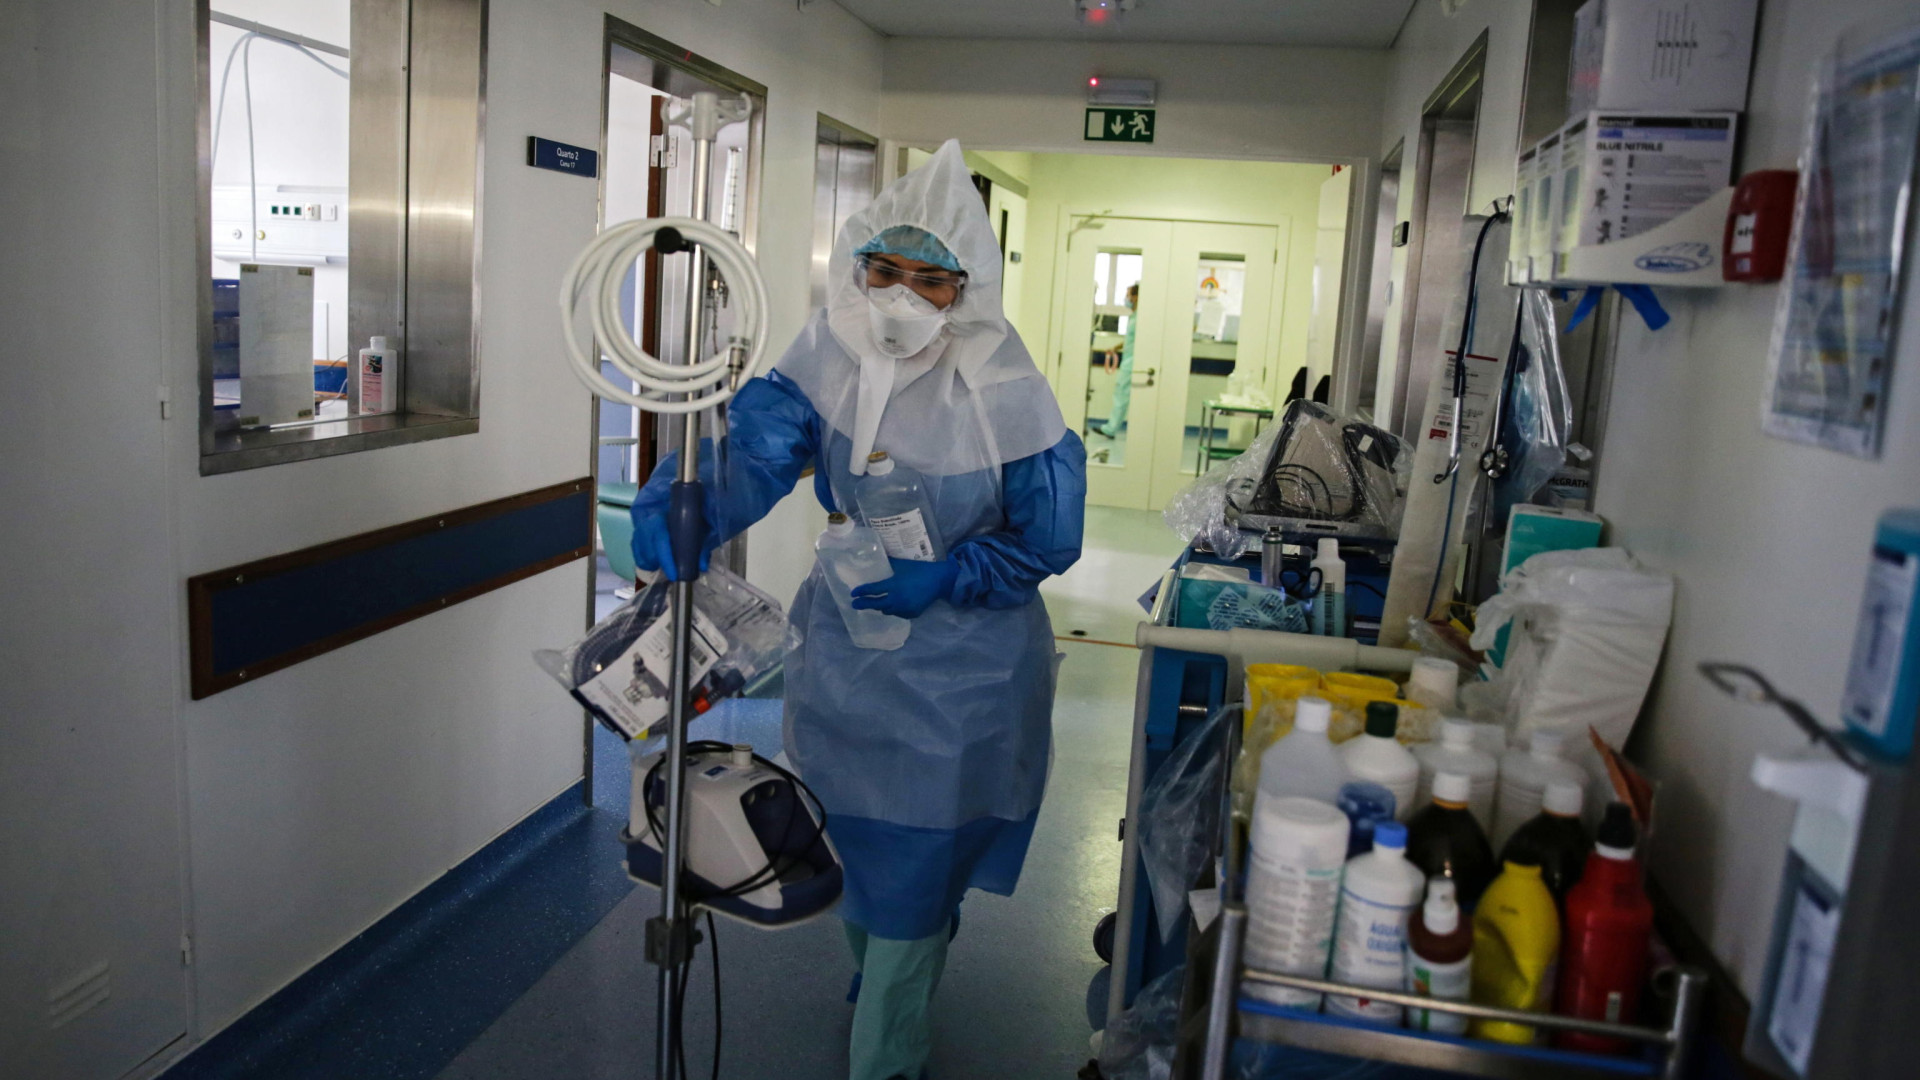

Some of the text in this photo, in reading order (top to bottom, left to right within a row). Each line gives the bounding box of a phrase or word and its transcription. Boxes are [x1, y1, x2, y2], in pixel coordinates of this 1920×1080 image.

[1596, 142, 1663, 151] BLUE NITRILE
[556, 147, 579, 161] Quarto 2
